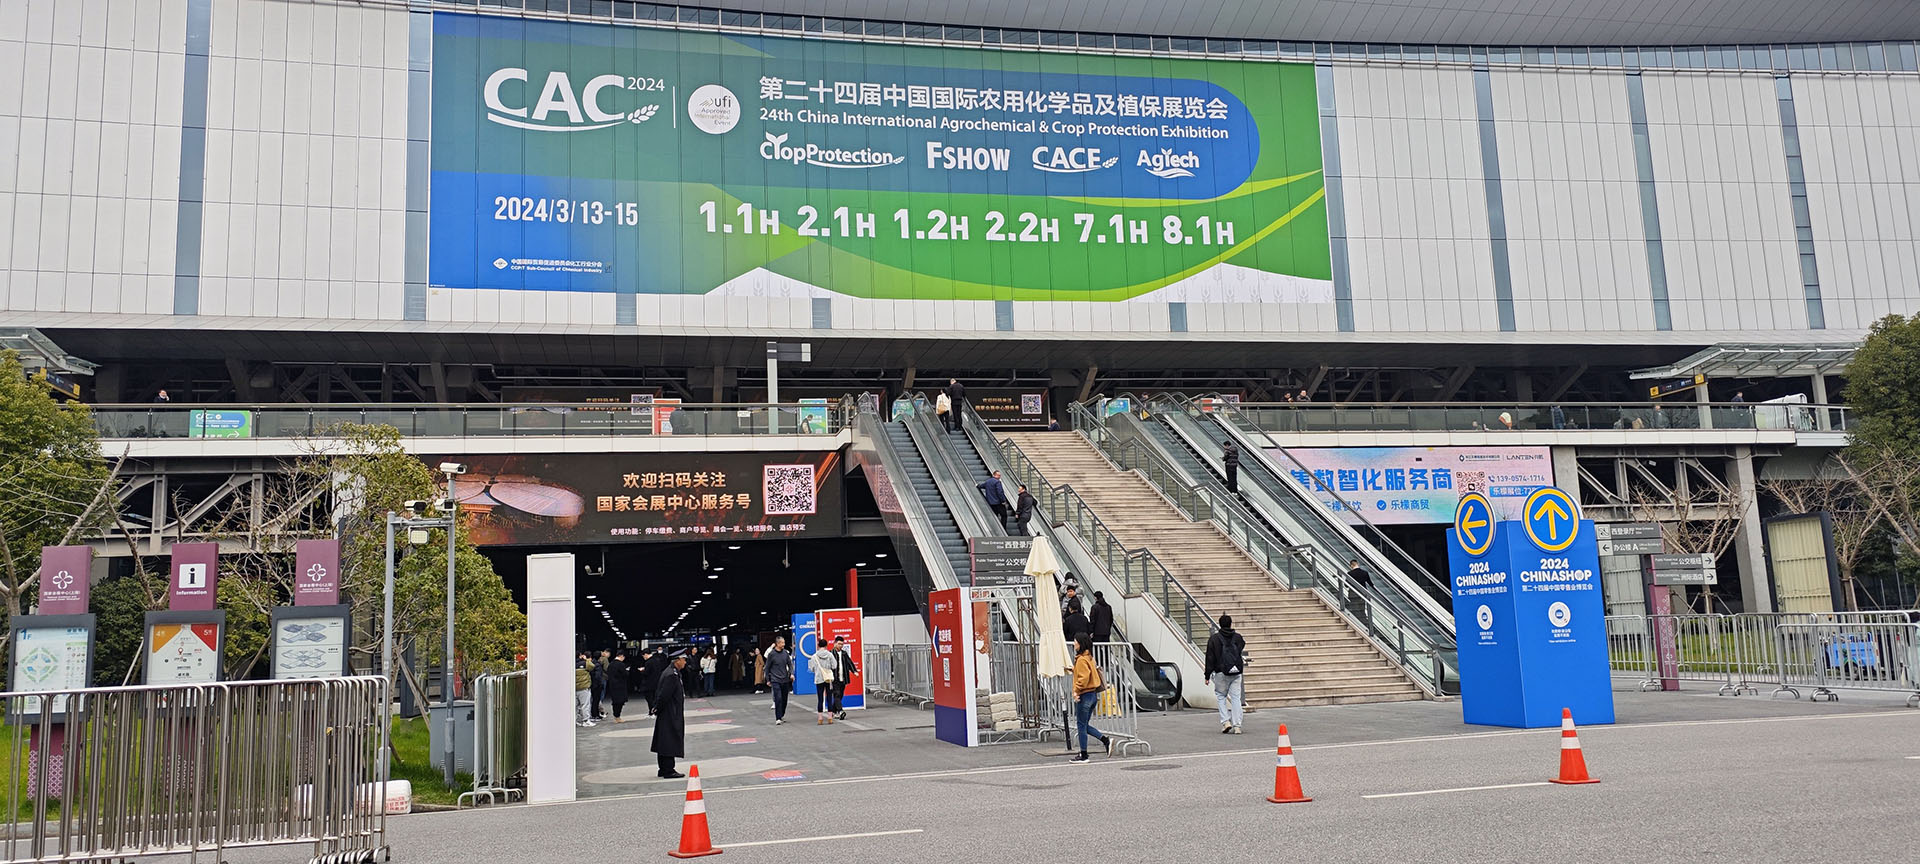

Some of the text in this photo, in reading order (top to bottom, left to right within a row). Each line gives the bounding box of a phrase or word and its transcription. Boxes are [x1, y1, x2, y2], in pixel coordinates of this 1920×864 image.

[484, 68, 666, 123] CAC 2024
[714, 95, 731, 108] ufi
[759, 75, 1229, 121] 第二十四届中国国际农用化学品及植保展览会
[759, 107, 1229, 139] 24th China International Agrochemical & Crop Protection Exhibition
[1032, 146, 1101, 170] CACE
[1137, 148, 1200, 171] AgTech
[494, 196, 638, 226] 2024/3/13-15
[699, 201, 1235, 245] 1.1H 2.1H 1.2H 2.2H 7.1H 8.1H
[623, 471, 726, 489] 欢迎扫码关注
[596, 493, 752, 512] 国家会展中心服务号
[1390, 499, 1430, 511] 乐檬商贸
[1469, 561, 1490, 574] 2024
[1540, 558, 1570, 570] 2024
[1456, 572, 1506, 587] CHINASHOP
[1520, 569, 1593, 582] CHINASHOP
